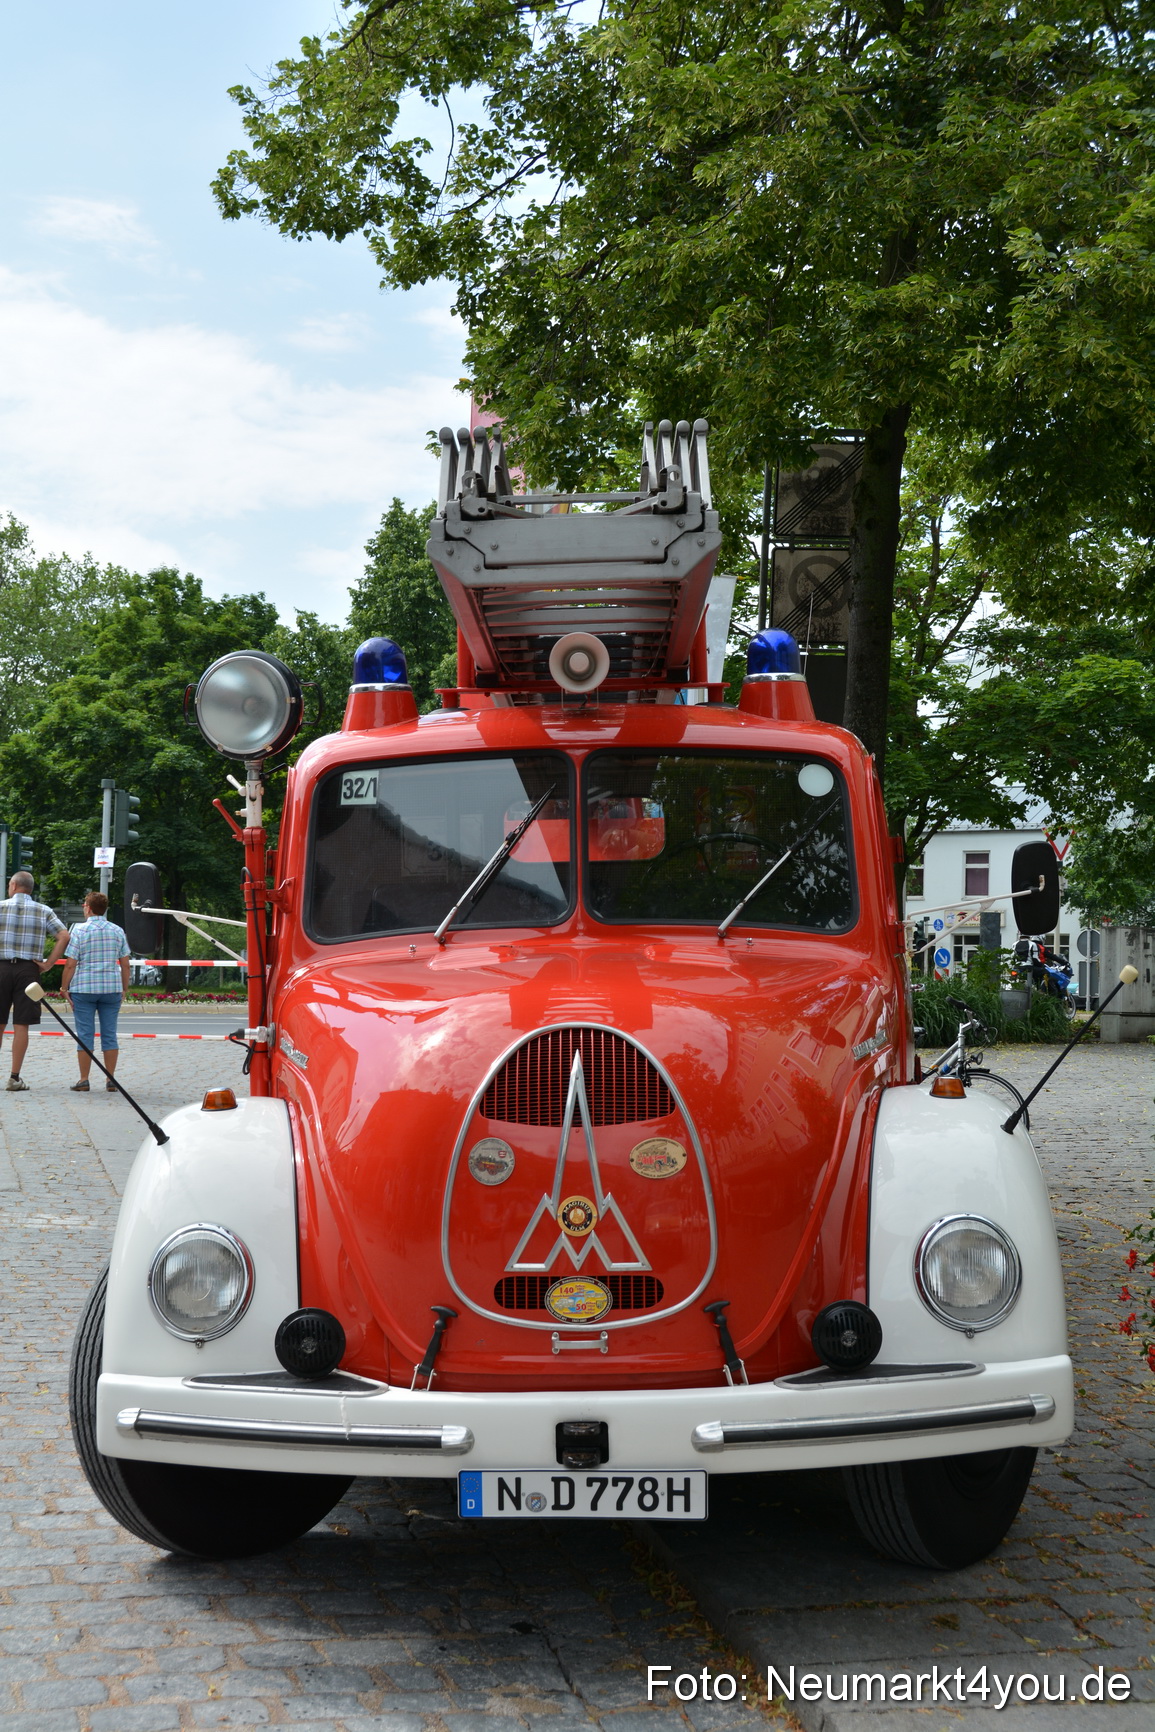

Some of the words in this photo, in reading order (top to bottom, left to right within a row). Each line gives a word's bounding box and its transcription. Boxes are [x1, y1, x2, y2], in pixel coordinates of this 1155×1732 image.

[343, 777, 377, 799] 32/1
[563, 1201, 591, 1214] MAGIRUS
[575, 1303, 587, 1311] 50
[466, 1499, 475, 1509] D
